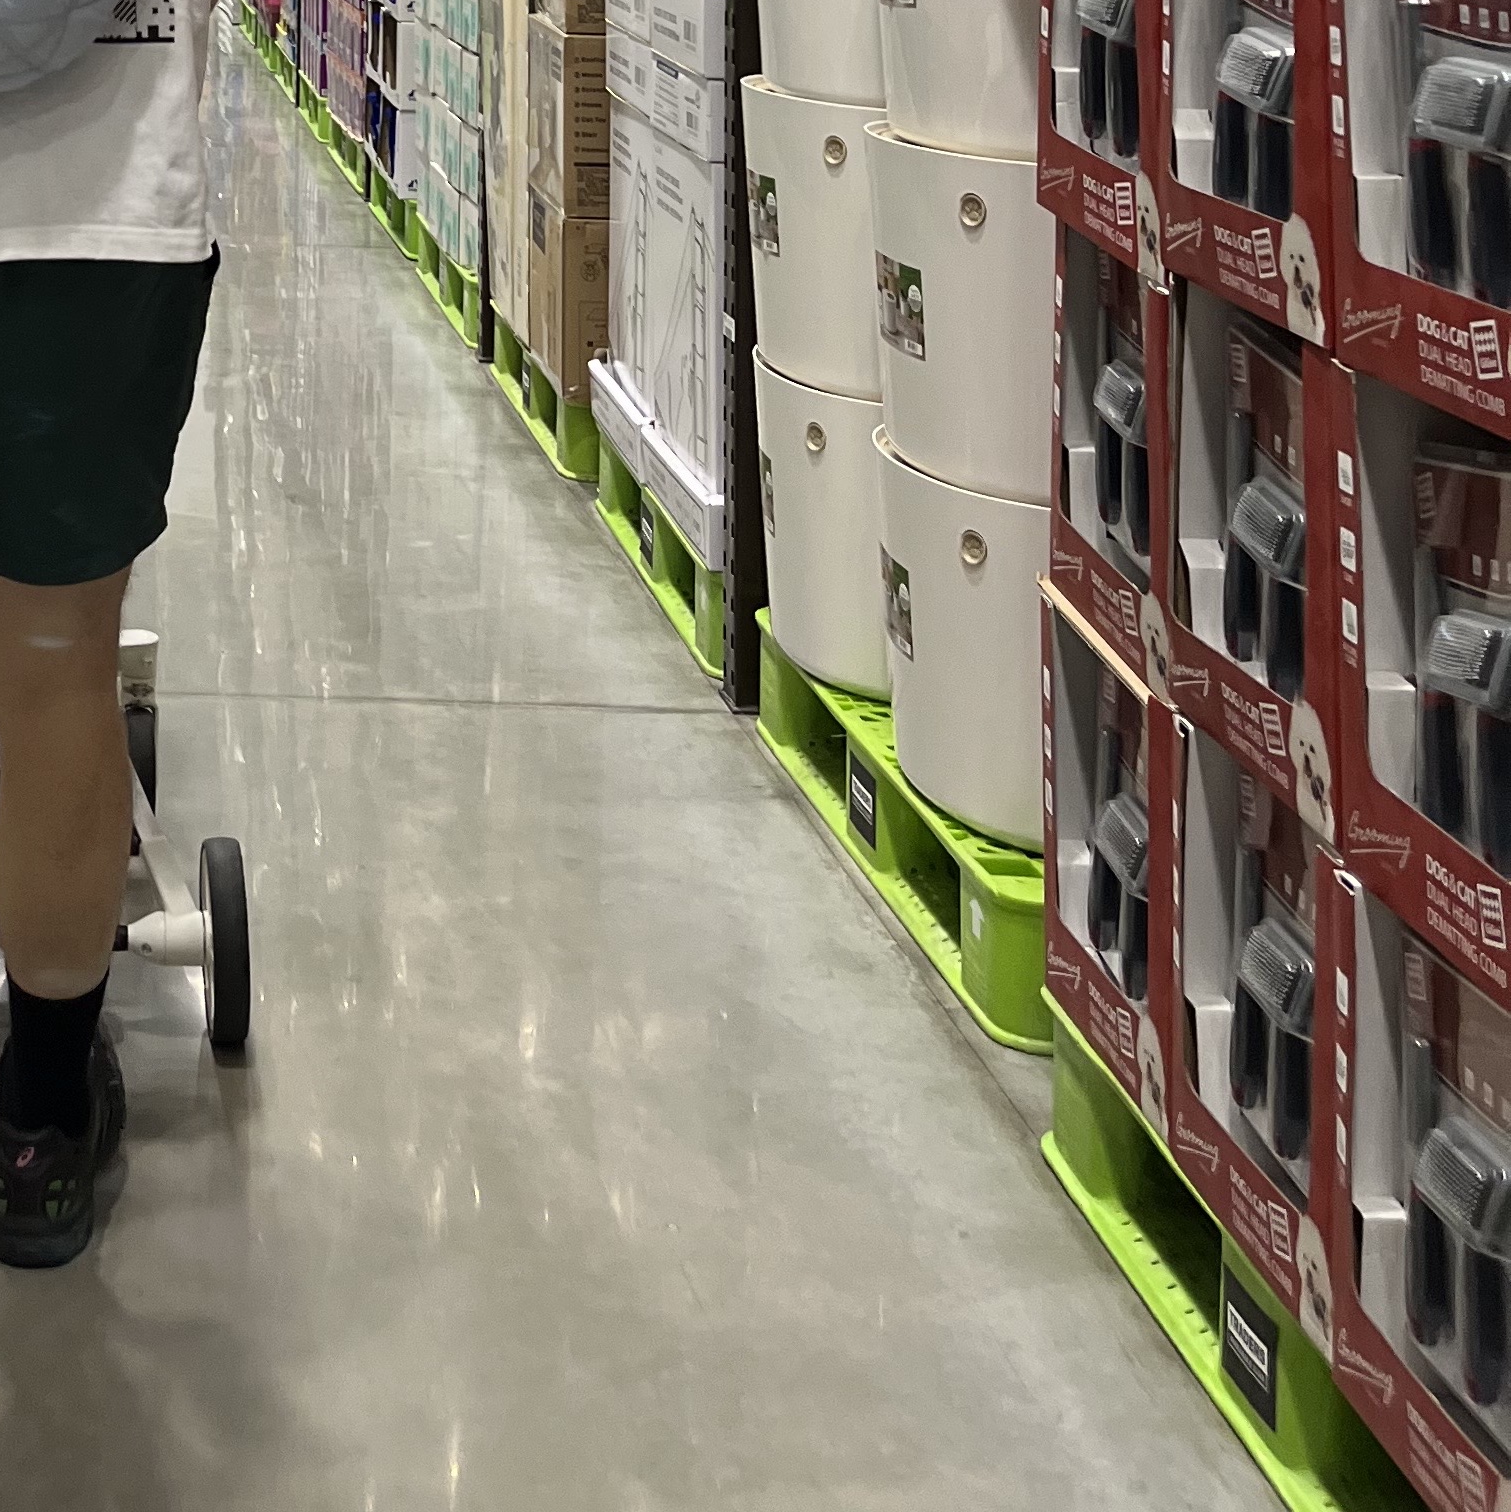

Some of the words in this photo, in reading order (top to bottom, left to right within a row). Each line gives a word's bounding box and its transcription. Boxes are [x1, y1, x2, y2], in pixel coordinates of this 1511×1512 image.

[1341, 297, 1402, 340] Grooming
[1417, 313, 1440, 339] DOG
[1449, 326, 1469, 350] CAT
[1419, 339, 1444, 366] DUAL
[1445, 351, 1472, 377] HEAD
[1476, 389, 1506, 417] COMB
[1348, 810, 1411, 869] Grooming
[1426, 854, 1448, 887] DOG
[1457, 880, 1477, 910] CAT
[1426, 880, 1451, 915] DUAL
[1452, 902, 1478, 936] HEAD
[1479, 952, 1508, 988] COMB
